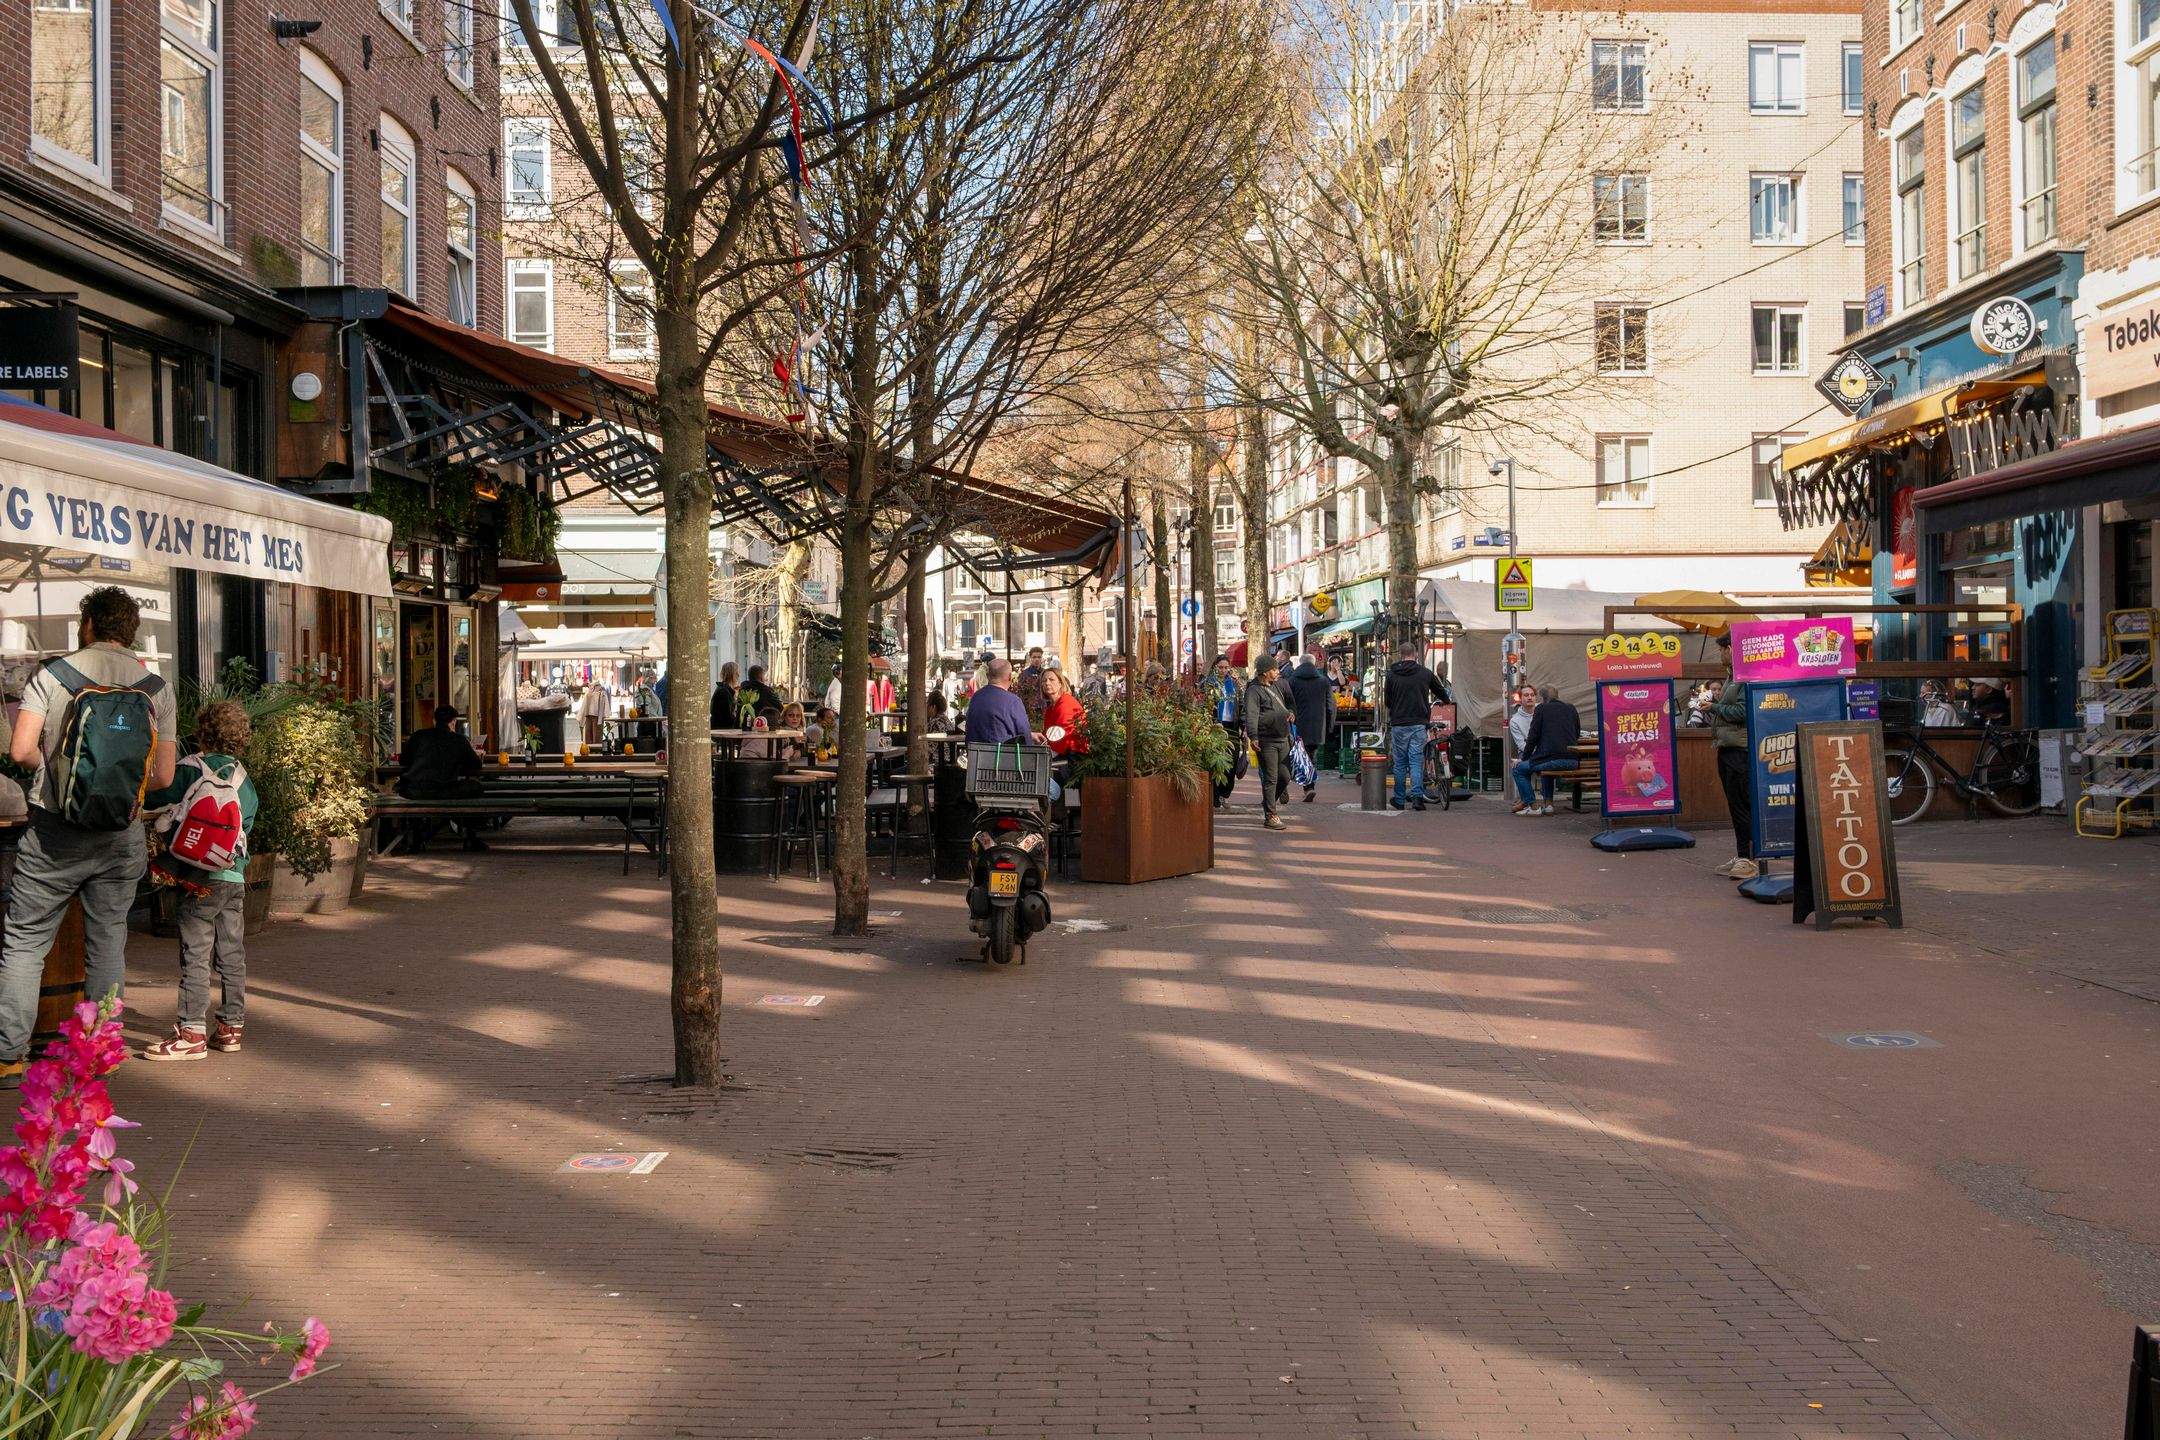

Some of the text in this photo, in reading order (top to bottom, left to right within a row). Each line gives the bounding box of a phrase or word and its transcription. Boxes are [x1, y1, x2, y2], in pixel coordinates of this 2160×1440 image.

[1984, 303, 2028, 337] Heineken's
[1992, 335, 2019, 349] Bier
[16, 366, 69, 379] LABELS
[0, 483, 303, 574] G VERS VAN HET MES
[1741, 633, 1785, 645] GEEN KADO
[1742, 640, 1785, 651] GEVONDEN?
[1590, 638, 1676, 655] 37 9 14 2 18
[1743, 650, 1785, 663] KRASLOT
[1800, 652, 1839, 664] KRASLOTEN
[1617, 712, 1659, 725] SPEK JIJ
[1617, 721, 1659, 733] JE KAS?
[1617, 729, 1659, 744] KRAS!
[1769, 784, 1790, 794] WIN
[1767, 795, 1788, 806] 120
[1827, 735, 1872, 897] TATTOO
[1000, 874, 1017, 883] FSV
[999, 883, 1016, 892] 24N
